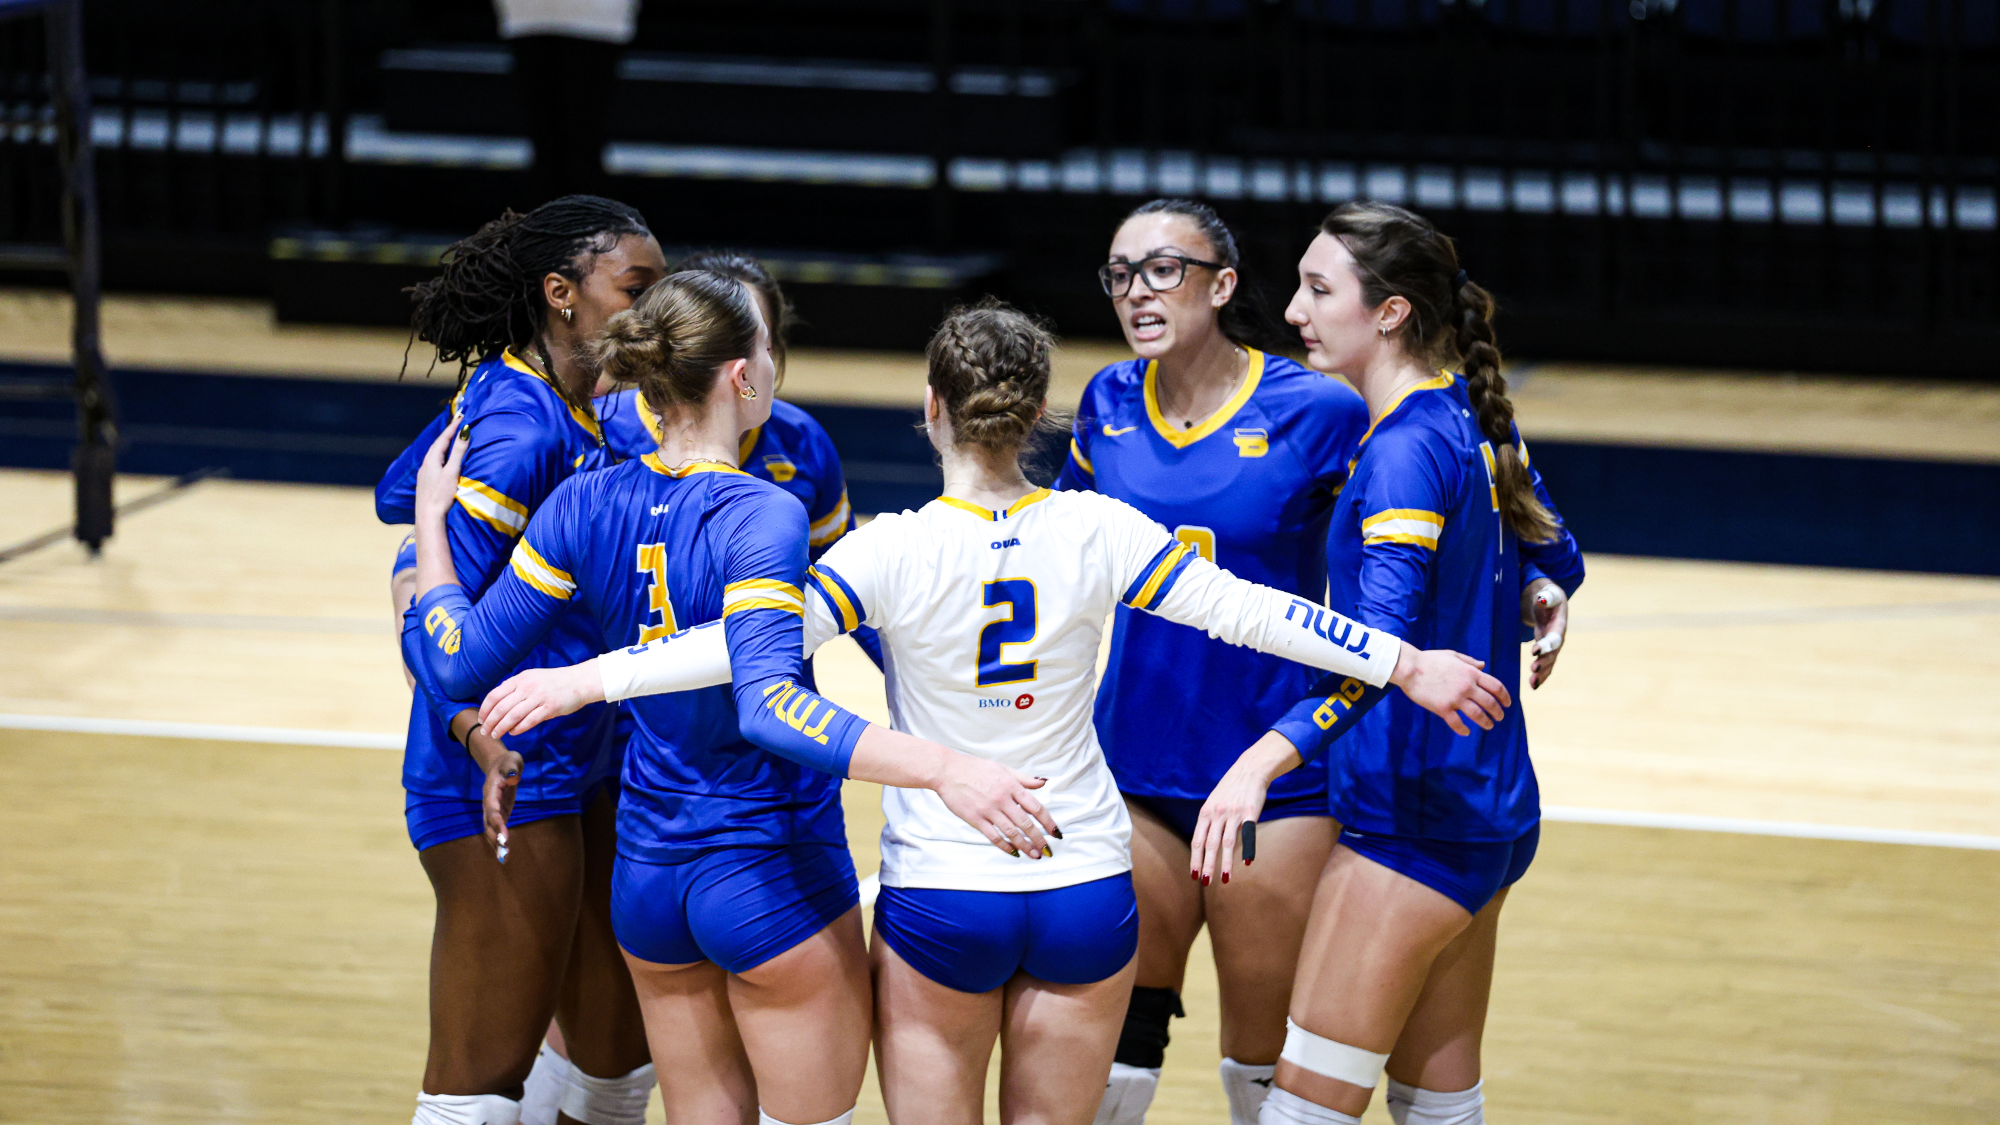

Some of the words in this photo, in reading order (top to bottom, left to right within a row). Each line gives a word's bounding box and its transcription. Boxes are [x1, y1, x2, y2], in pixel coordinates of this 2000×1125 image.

[990, 537, 1021, 550] OUA
[636, 542, 679, 645] 3
[424, 605, 462, 656] OLD
[975, 577, 1039, 688] 2
[978, 698, 1011, 708] BMO
[1312, 676, 1370, 731] OLD
